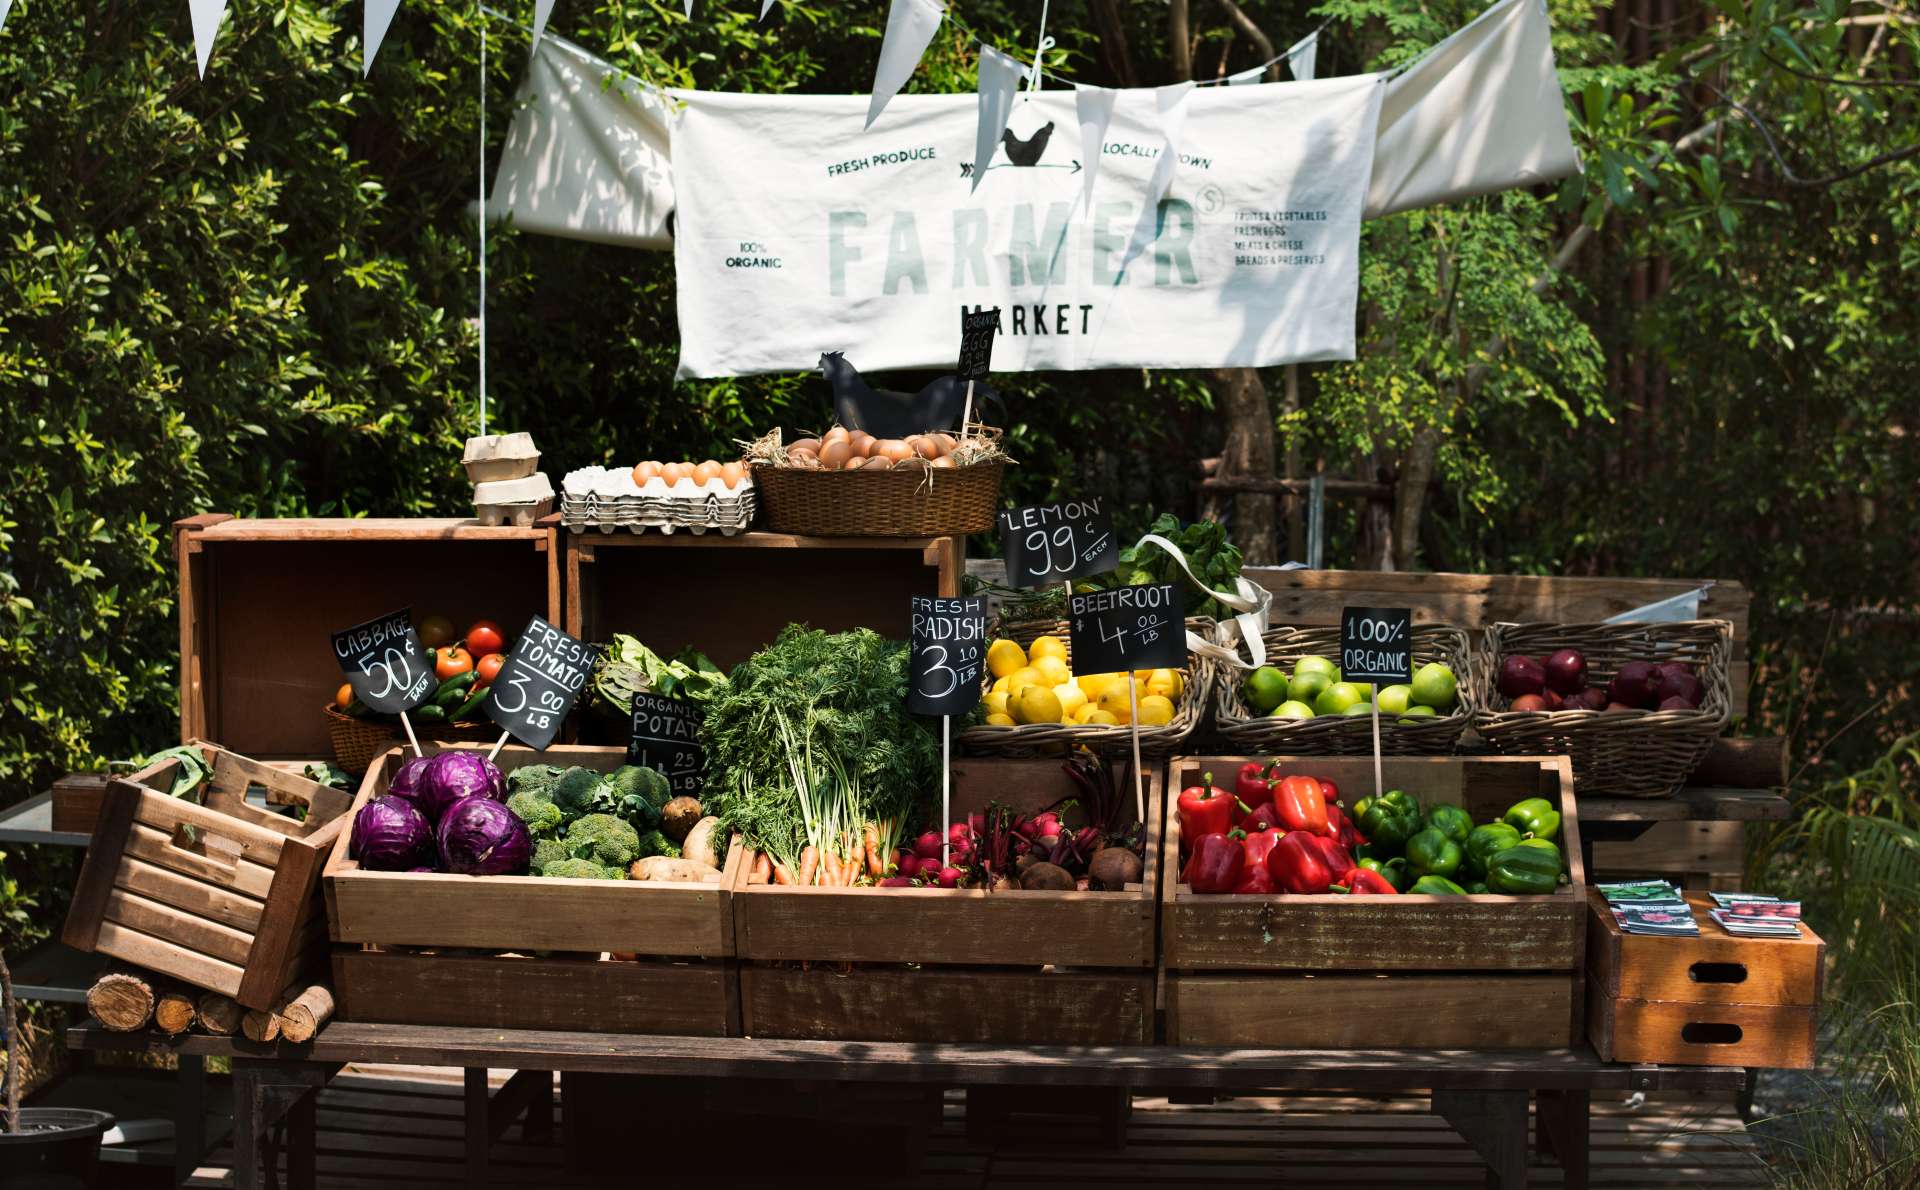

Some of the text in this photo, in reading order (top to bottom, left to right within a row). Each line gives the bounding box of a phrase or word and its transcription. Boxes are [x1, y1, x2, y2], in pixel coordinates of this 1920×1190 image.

[828, 147, 936, 177] FRESH PRODUCE
[1103, 143, 1212, 169] LOCALLY OWN
[740, 242, 767, 253] 100%
[829, 197, 1199, 297] FARMER
[726, 257, 782, 269] ORGANIC
[1085, 541, 1108, 561] EACH
[912, 597, 980, 614] FRESH
[1072, 585, 1172, 615] BEETROOT
[913, 613, 985, 640] RADISH
[1137, 614, 1157, 628] 00
[1348, 616, 1405, 643] 100%
[335, 614, 412, 658] CABBAGE
[528, 619, 596, 671] FRESH
[1142, 630, 1159, 645] LB
[520, 635, 585, 690] TOMATO
[960, 646, 978, 662] 10
[1344, 648, 1408, 672] ORGANIC
[960, 667, 977, 685] LB
[410, 678, 429, 702] EACH
[494, 669, 564, 713] 3 00
[635, 695, 700, 721] ORGANIC
[526, 712, 551, 729] LB
[633, 711, 702, 740] POTAT
[674, 752, 696, 768] 25
[673, 776, 696, 790] LB
